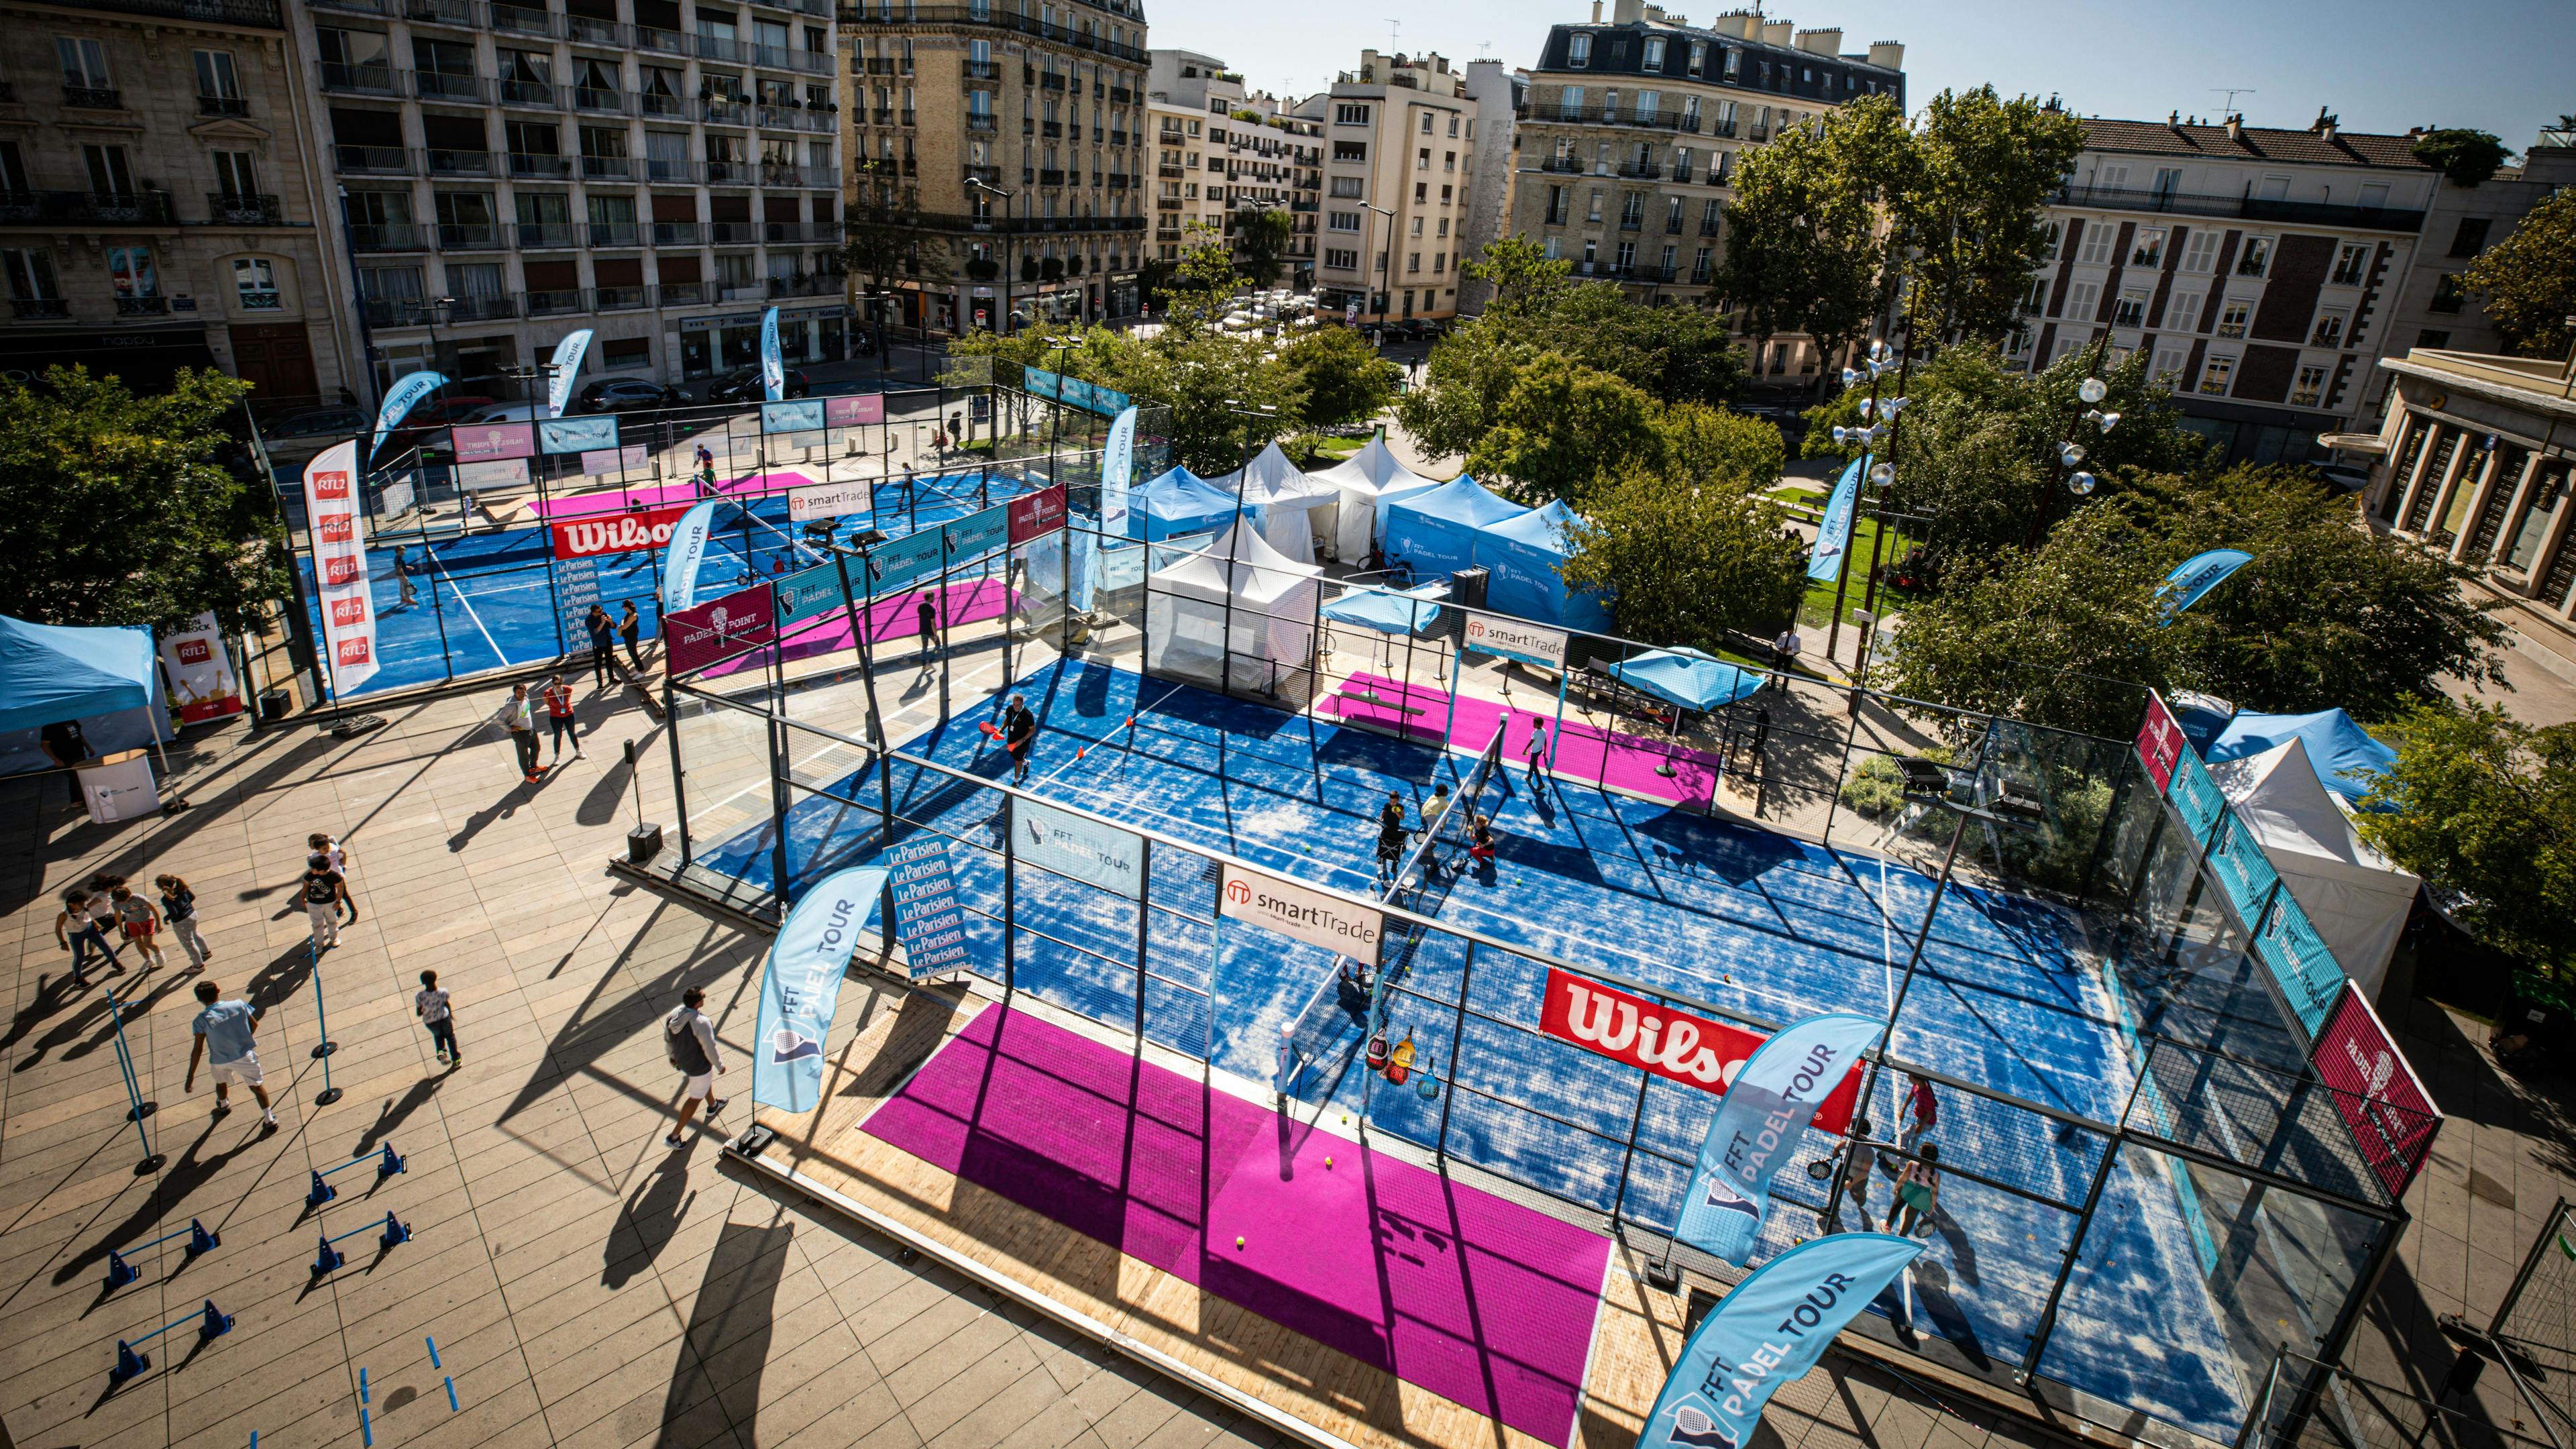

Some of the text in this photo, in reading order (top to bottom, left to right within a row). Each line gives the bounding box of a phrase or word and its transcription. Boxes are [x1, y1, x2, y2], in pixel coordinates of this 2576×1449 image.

[102, 335, 154, 348] happy
[566, 342, 581, 366] TOUR
[399, 380, 426, 404] TOUR
[1118, 426, 1128, 458] TOUR
[317, 479, 345, 490] RTL2
[808, 490, 869, 506] smartTrade
[1835, 472, 1860, 537] PADEL TOUR
[324, 523, 350, 533] RTL2
[1019, 513, 1034, 523] PADEL
[1827, 519, 1836, 535] FFT
[985, 525, 1004, 537] TOUR
[566, 559, 593, 570] Parisien
[888, 554, 901, 563] FFT
[888, 549, 938, 572] PADEL TOUR
[1413, 549, 1436, 558] PADEL
[330, 566, 355, 576] RTL2
[567, 570, 595, 581] Parisien
[679, 525, 702, 606] PADEL TOUR
[569, 582, 596, 592] Parisien
[802, 584, 816, 596] FFT
[836, 577, 861, 592] TUR
[1511, 574, 1549, 593] PADEL TOUR
[570, 593, 598, 604] Parisien
[671, 590, 679, 609] FFT
[336, 604, 362, 618] RTL2
[684, 613, 756, 644] PADEL POINT
[182, 645, 206, 658] RTL2
[341, 644, 366, 657] RTL2
[1489, 629, 1564, 656] smartTrade
[1054, 829, 1073, 841] FFT
[890, 841, 943, 864] Le Parisien
[1054, 839, 1130, 873] PADEL TOUR
[894, 859, 947, 883] Le Parisien
[898, 878, 951, 902] Le Parisien
[902, 896, 955, 920] Le Parisien
[1258, 894, 1375, 943] smartTrade
[907, 913, 958, 938] Le Parisien
[910, 930, 961, 953] Le Parisien
[798, 899, 855, 1020] PADEL TOUR
[913, 946, 964, 967] Le Parisien
[783, 986, 800, 1015] FFT
[2302, 973, 2326, 1014] TOUR
[2346, 1037, 2371, 1083] PADEL
[1741, 1044, 1837, 1183] PADEL TOUR
[1724, 1130, 1750, 1171] FFT
[1722, 1273, 1856, 1417] PADEL TOUR
[1700, 1356, 1732, 1402] FFT
